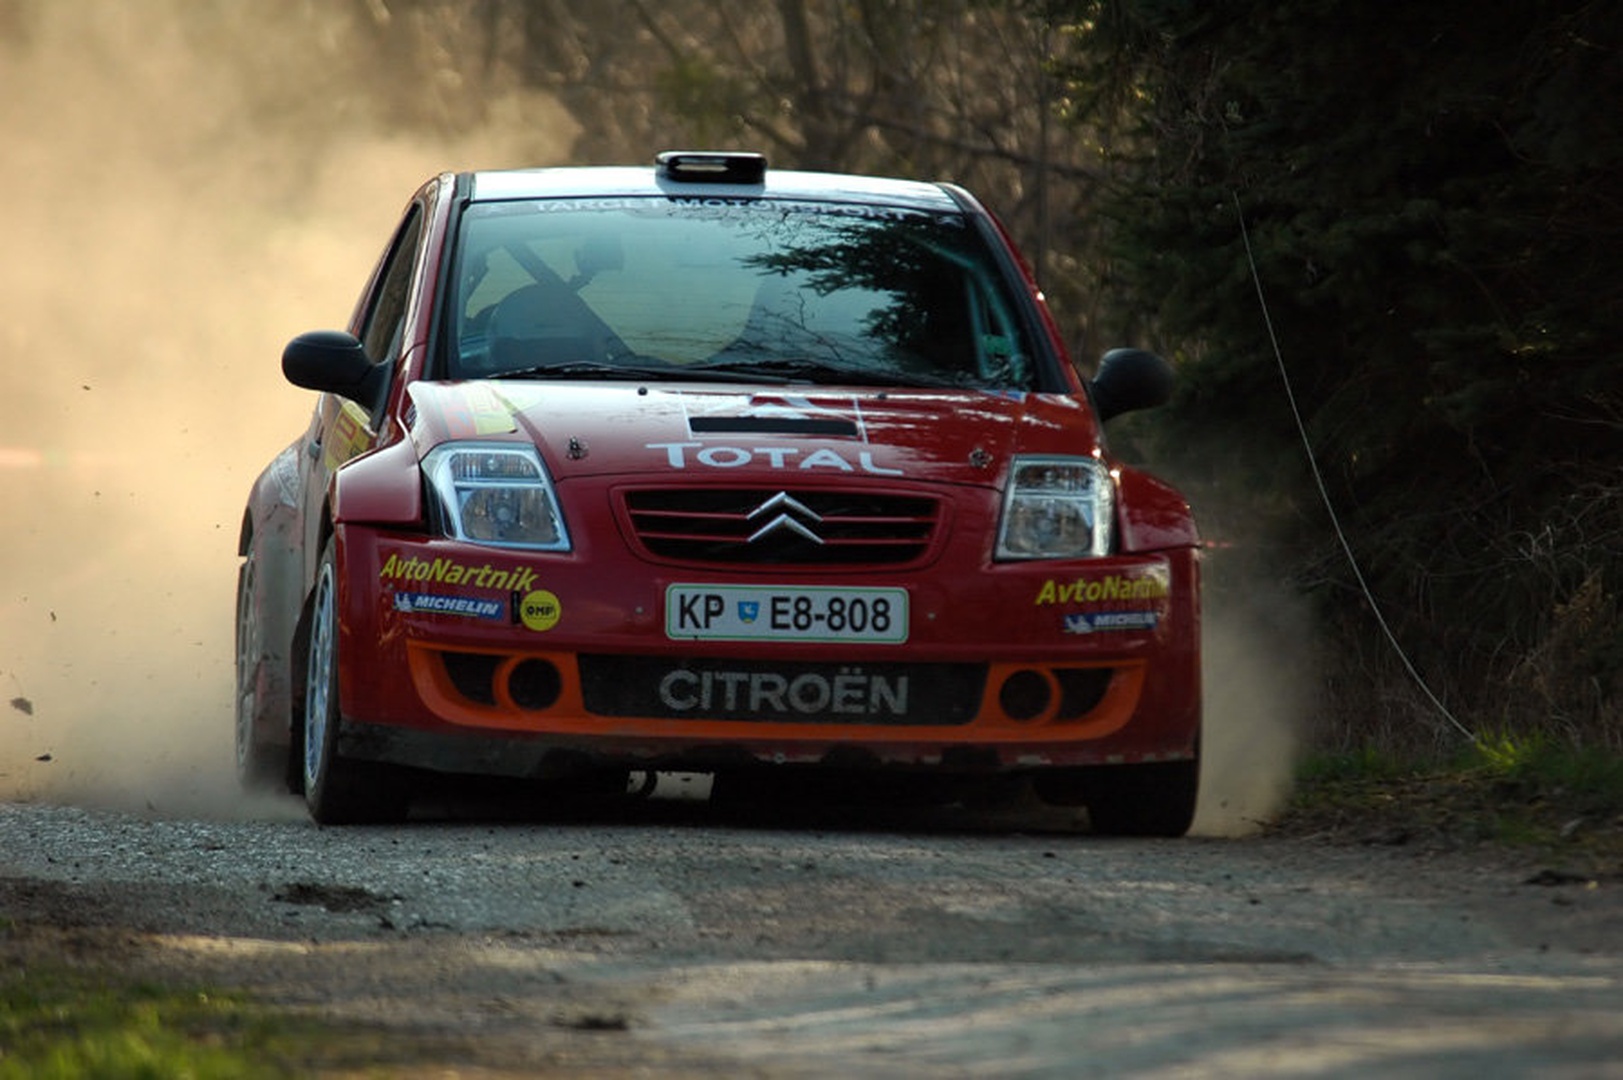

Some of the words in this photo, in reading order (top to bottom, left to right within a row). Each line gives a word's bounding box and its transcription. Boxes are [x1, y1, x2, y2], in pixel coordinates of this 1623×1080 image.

[646, 442, 904, 476] TOTAL
[379, 554, 538, 592] AvtoNartnik
[414, 596, 499, 616] MICHELIN
[679, 594, 724, 629] KP
[770, 596, 891, 632] E8-808
[659, 667, 909, 714] CITROËN
